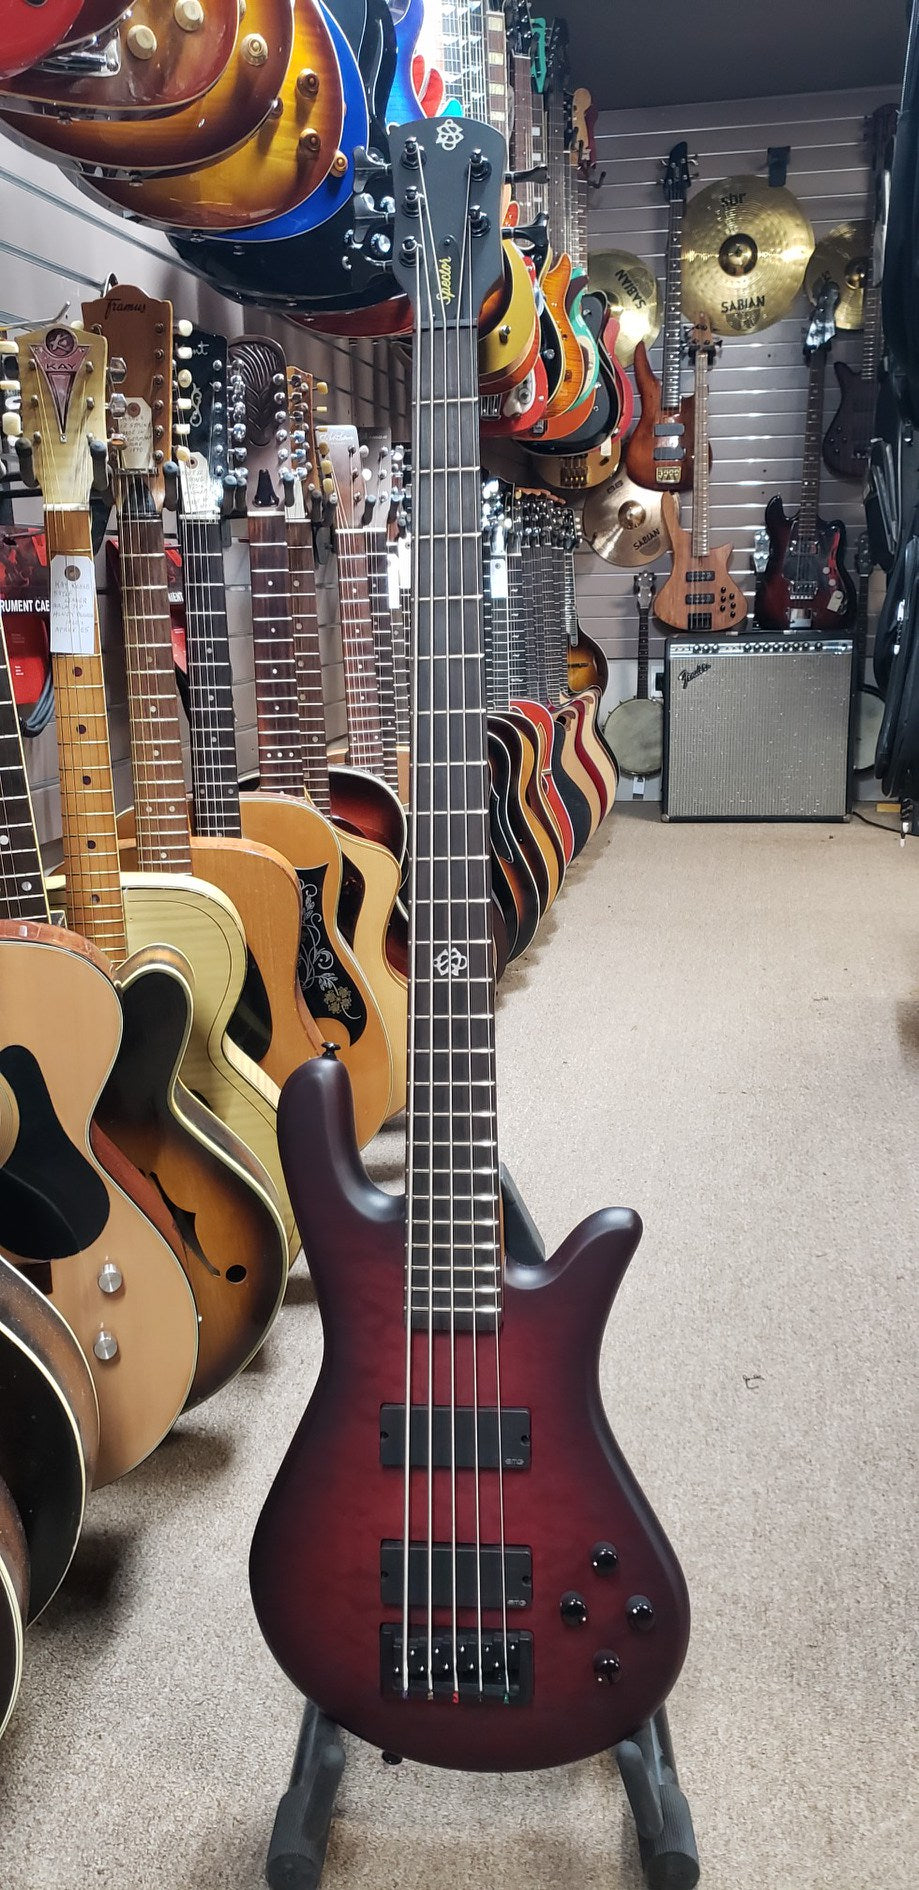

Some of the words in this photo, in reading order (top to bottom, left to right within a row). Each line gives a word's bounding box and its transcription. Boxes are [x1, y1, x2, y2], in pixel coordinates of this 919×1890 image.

[436, 256, 456, 306] Spector
[615, 269, 647, 309] SABIAN
[721, 295, 766, 314] SABIAN
[46, 363, 77, 371] KAY
[632, 528, 661, 551] SABIAN
[0, 599, 33, 612] RUMENT
[678, 663, 712, 690] Fender
